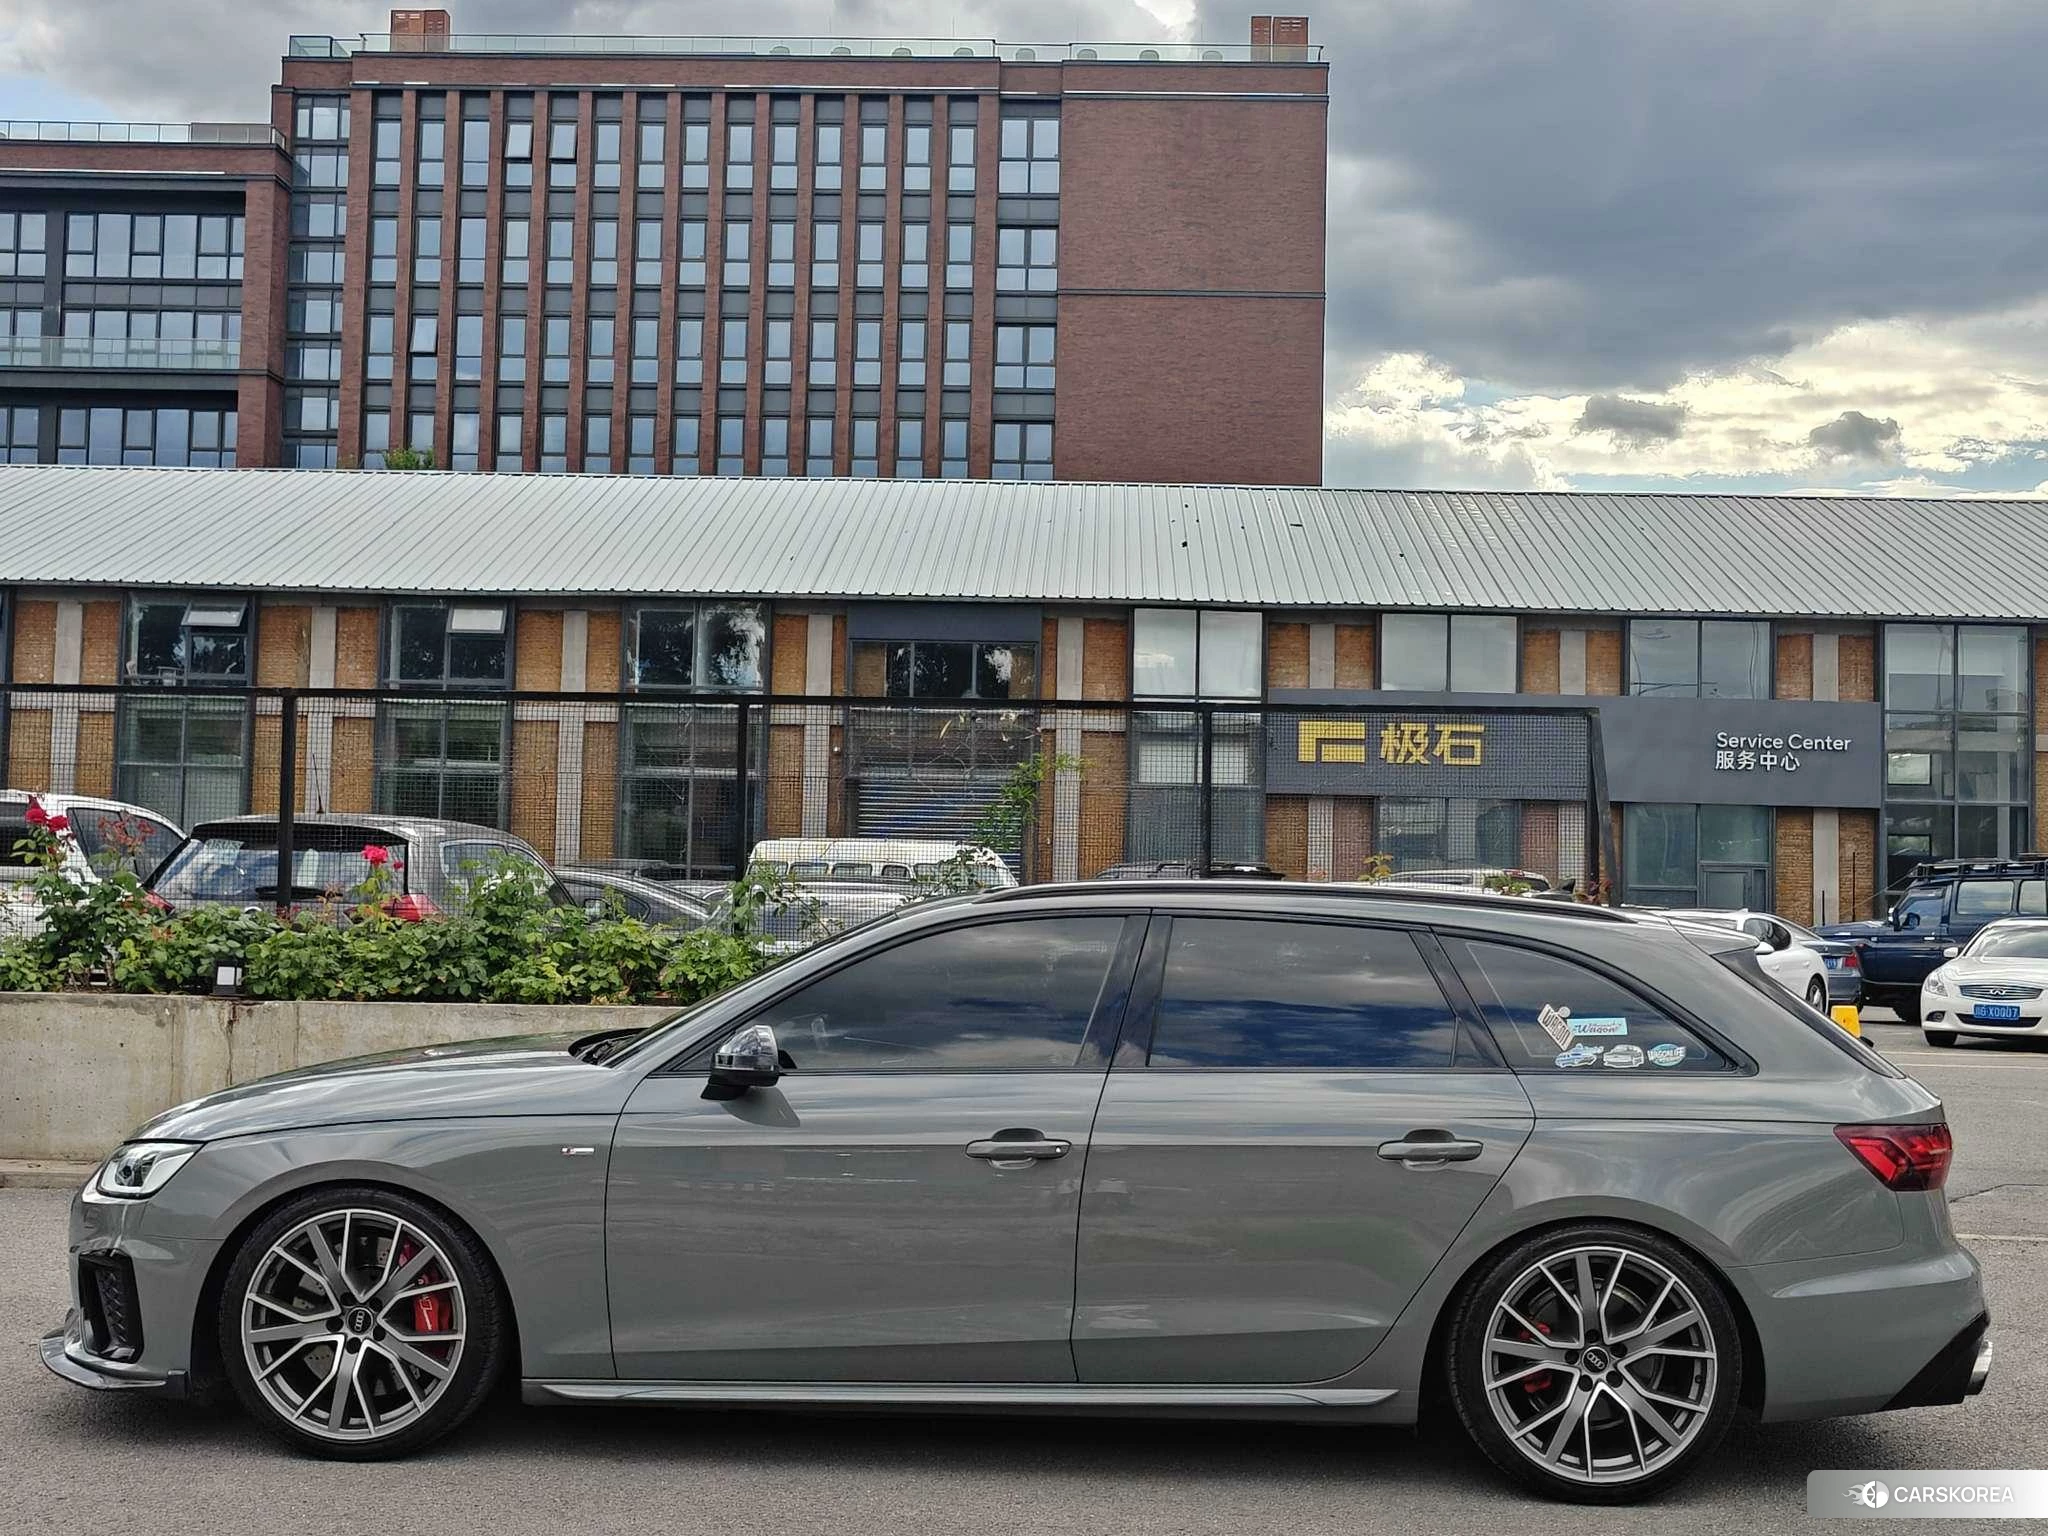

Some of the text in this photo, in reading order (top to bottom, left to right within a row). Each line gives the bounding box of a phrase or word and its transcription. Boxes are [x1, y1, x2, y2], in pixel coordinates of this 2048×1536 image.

[1379, 722, 1485, 765] 极石
[1716, 732, 1852, 751] Service Center
[1715, 750, 1800, 771] 服务中心
